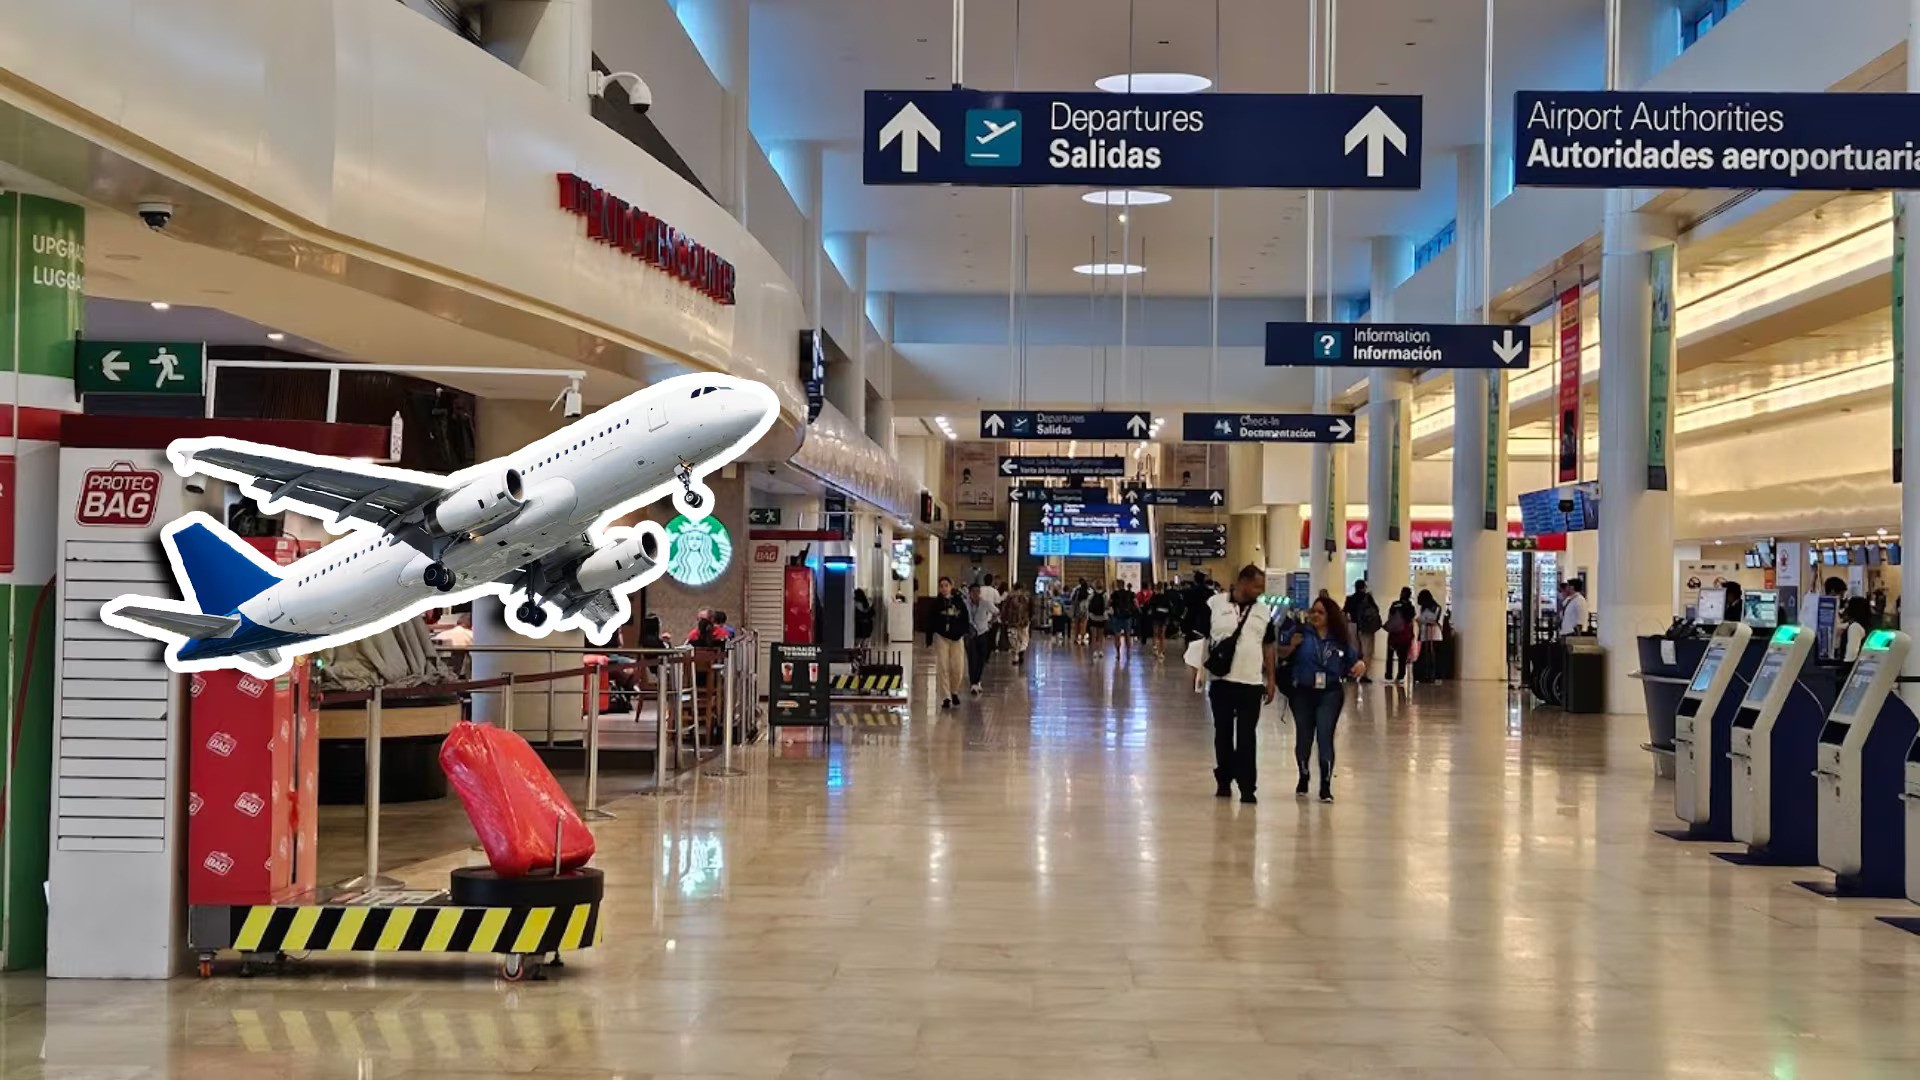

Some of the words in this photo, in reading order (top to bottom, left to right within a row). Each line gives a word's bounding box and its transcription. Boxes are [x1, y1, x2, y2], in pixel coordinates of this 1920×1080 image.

[1049, 102, 1204, 135] Departures
[1527, 101, 1623, 136] Airport
[1630, 101, 1784, 132] Authorities
[1048, 139, 1162, 170] Salidas
[1526, 138, 1715, 170] Autoridades
[33, 265, 85, 294] LUGGA
[1353, 328, 1431, 343] Information
[1353, 345, 1443, 361] Información
[1036, 413, 1085, 425] Departures
[1239, 415, 1280, 427] Check-In
[1036, 424, 1073, 435] Salidas
[1239, 427, 1317, 439] Documentación
[88, 475, 154, 491] PROTEC
[83, 491, 151, 518] BAG
